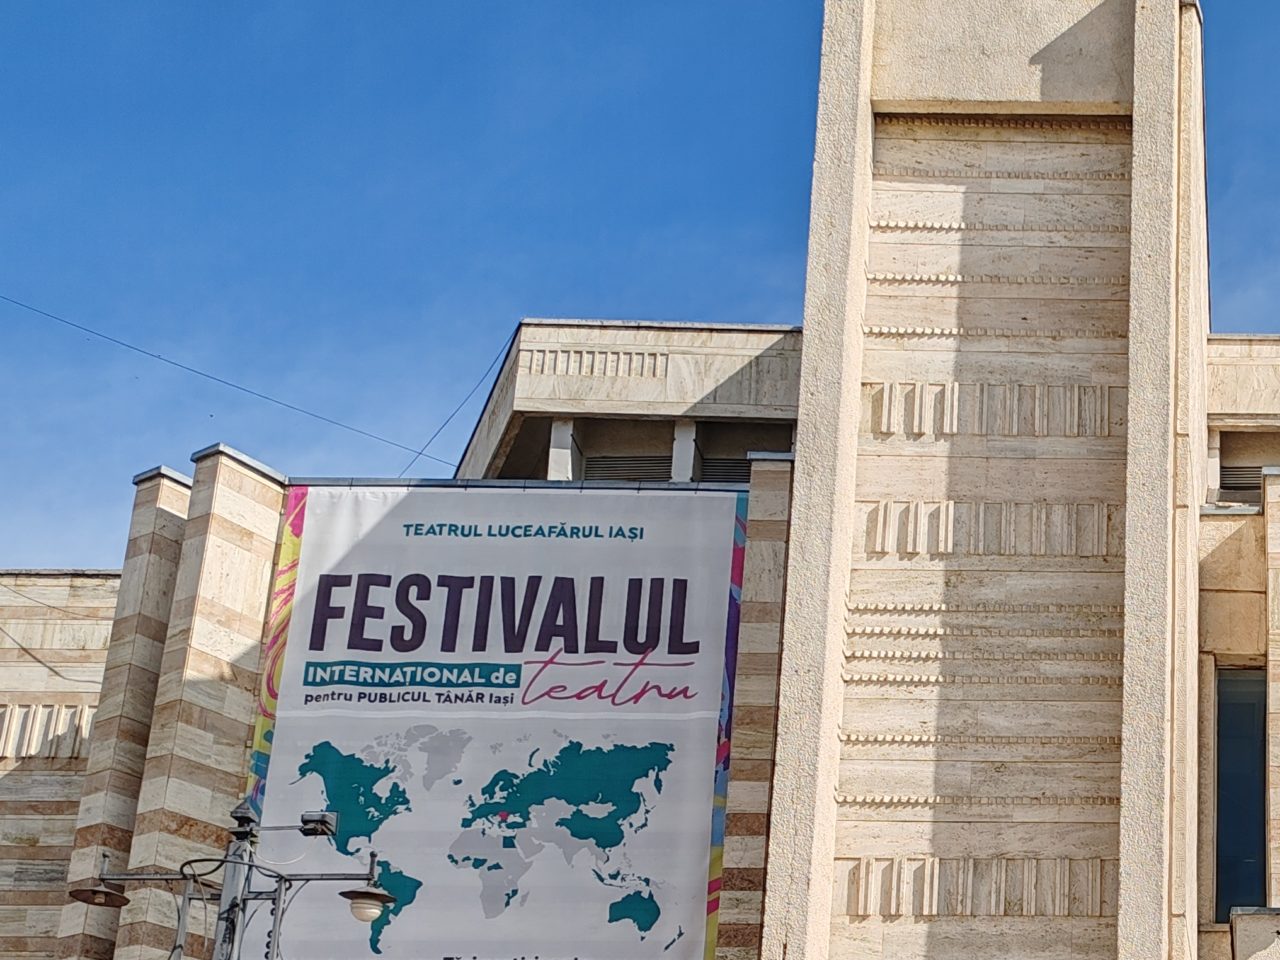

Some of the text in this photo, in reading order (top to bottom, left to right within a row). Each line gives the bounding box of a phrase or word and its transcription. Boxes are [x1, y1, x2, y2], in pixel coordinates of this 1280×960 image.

[403, 522, 644, 542] TEATRUL LUCEAFĂRUL IAȘI
[308, 573, 700, 655] FESTIVALUL
[307, 666, 517, 686] INTERNAȚIONAL de
[521, 647, 698, 707] teatru
[304, 690, 514, 706] pentru PUBLICUL TÂNĂR Iași
